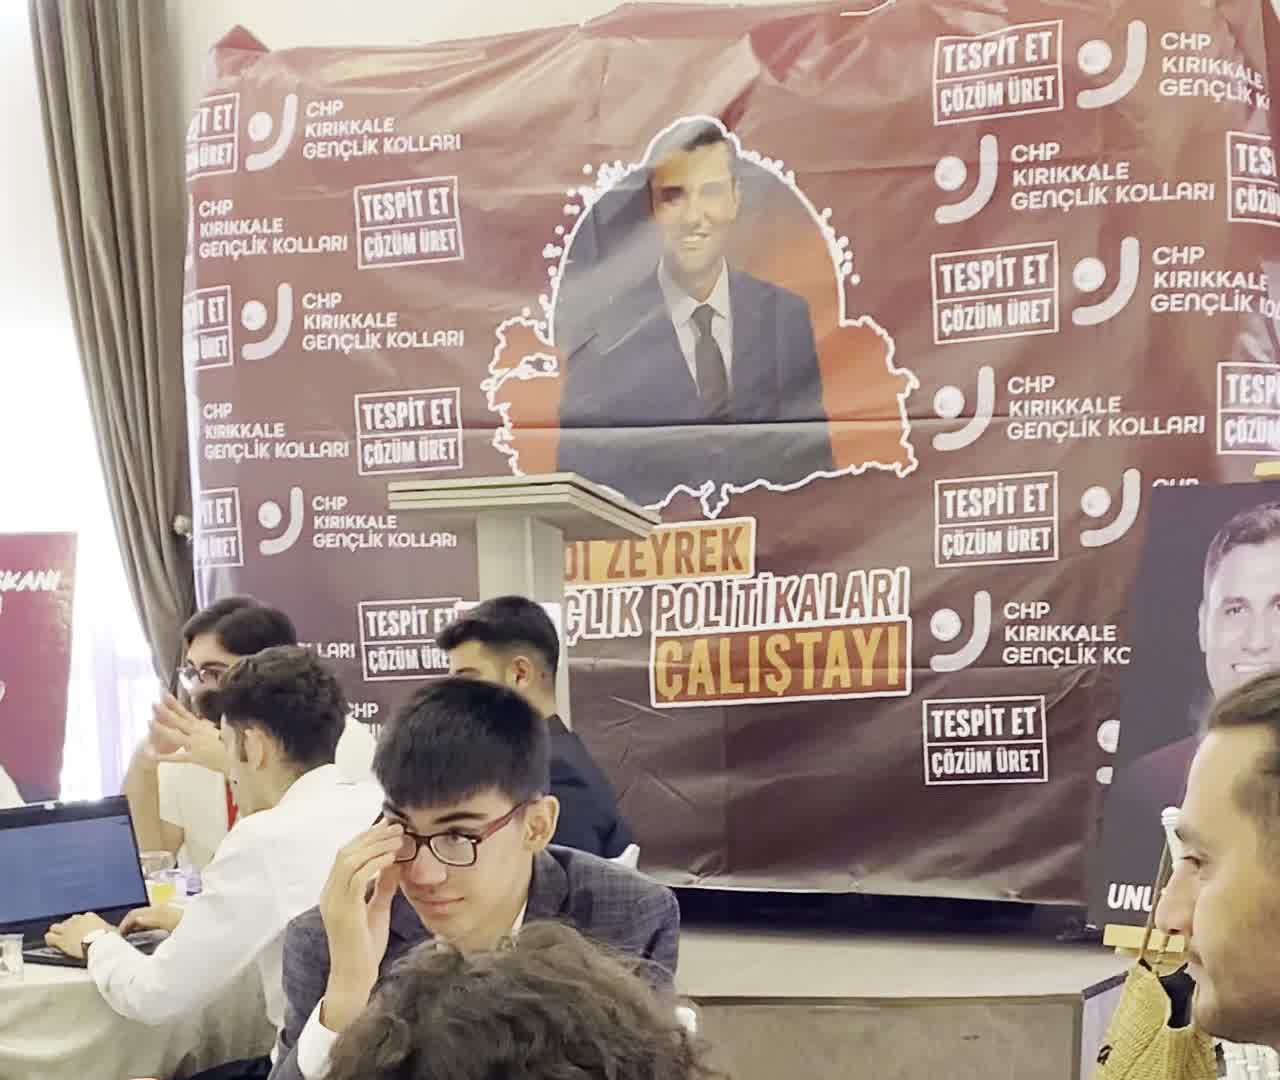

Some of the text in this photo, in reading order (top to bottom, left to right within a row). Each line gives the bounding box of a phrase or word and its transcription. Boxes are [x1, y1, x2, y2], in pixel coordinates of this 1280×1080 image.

[942, 31, 1053, 73] TESPİT ET
[1160, 32, 1211, 51] CHP
[1161, 56, 1264, 90] KIRIKKALE
[940, 75, 1055, 116] ÇÖZÜM ÜRET
[1159, 78, 1252, 105] GENÇLİK
[305, 99, 344, 118] CHP
[304, 117, 395, 138] KIRIKKALE
[302, 133, 462, 162] GENÇLİK KOLLARI
[1010, 142, 1060, 164] CHP
[1235, 143, 1277, 177] TES
[1013, 162, 1129, 187] KIRIKKALE
[199, 199, 233, 217] CHP
[361, 185, 449, 223] TESPİT ET
[1010, 182, 1216, 212] GENÇLİK KOLLARI
[199, 217, 284, 238] KIRIKKALE
[199, 235, 348, 260] GENÇLİK KOLLARI
[364, 227, 457, 262] ÇÖZÜM ÜRET
[1152, 246, 1205, 265] CHP
[939, 252, 1050, 294] TESPİT ET
[1153, 270, 1269, 291] KIRIKKALE
[302, 292, 342, 309] CHP
[1150, 289, 1254, 316] GENÇLİK
[303, 312, 398, 330] KIRIKKALE
[940, 298, 1051, 336] ÇÖZÜM ÜRET
[302, 330, 464, 355] GENÇLİK KOLLARI
[1007, 375, 1055, 395] CHP
[203, 403, 233, 419] CHP
[362, 397, 453, 430] TESPİT ET
[1008, 396, 1121, 417] KIRIKKALE
[204, 422, 286, 440] KIRIKKALE
[1007, 415, 1206, 443] GENÇLİK KOLLARI
[204, 439, 349, 464] GENÇLİK KOLLARI
[363, 436, 457, 468] ÇÖZÜM ÜRET
[312, 496, 348, 511] CHP
[943, 481, 1050, 519] TESPİT ET
[313, 515, 398, 529] KIRIKKALE
[313, 530, 457, 553] GENÇLİK KOLLARI
[607, 526, 744, 579] ZEYREK
[942, 525, 1051, 560] ÇÖZÜM ÜRET
[652, 566, 911, 632] POLİTİKALARI
[1003, 601, 1050, 620] CHP
[366, 606, 428, 637] TESPİT
[1005, 624, 1117, 642] KIRIKKALE
[368, 645, 419, 674] ÇÖZÜM
[655, 626, 901, 703] ÇALIŞTAYI
[1002, 643, 1097, 669] GENÇLİK
[931, 704, 1037, 738] TESPİT ET
[931, 747, 1041, 778] ÇÖZÜM ÜRET
